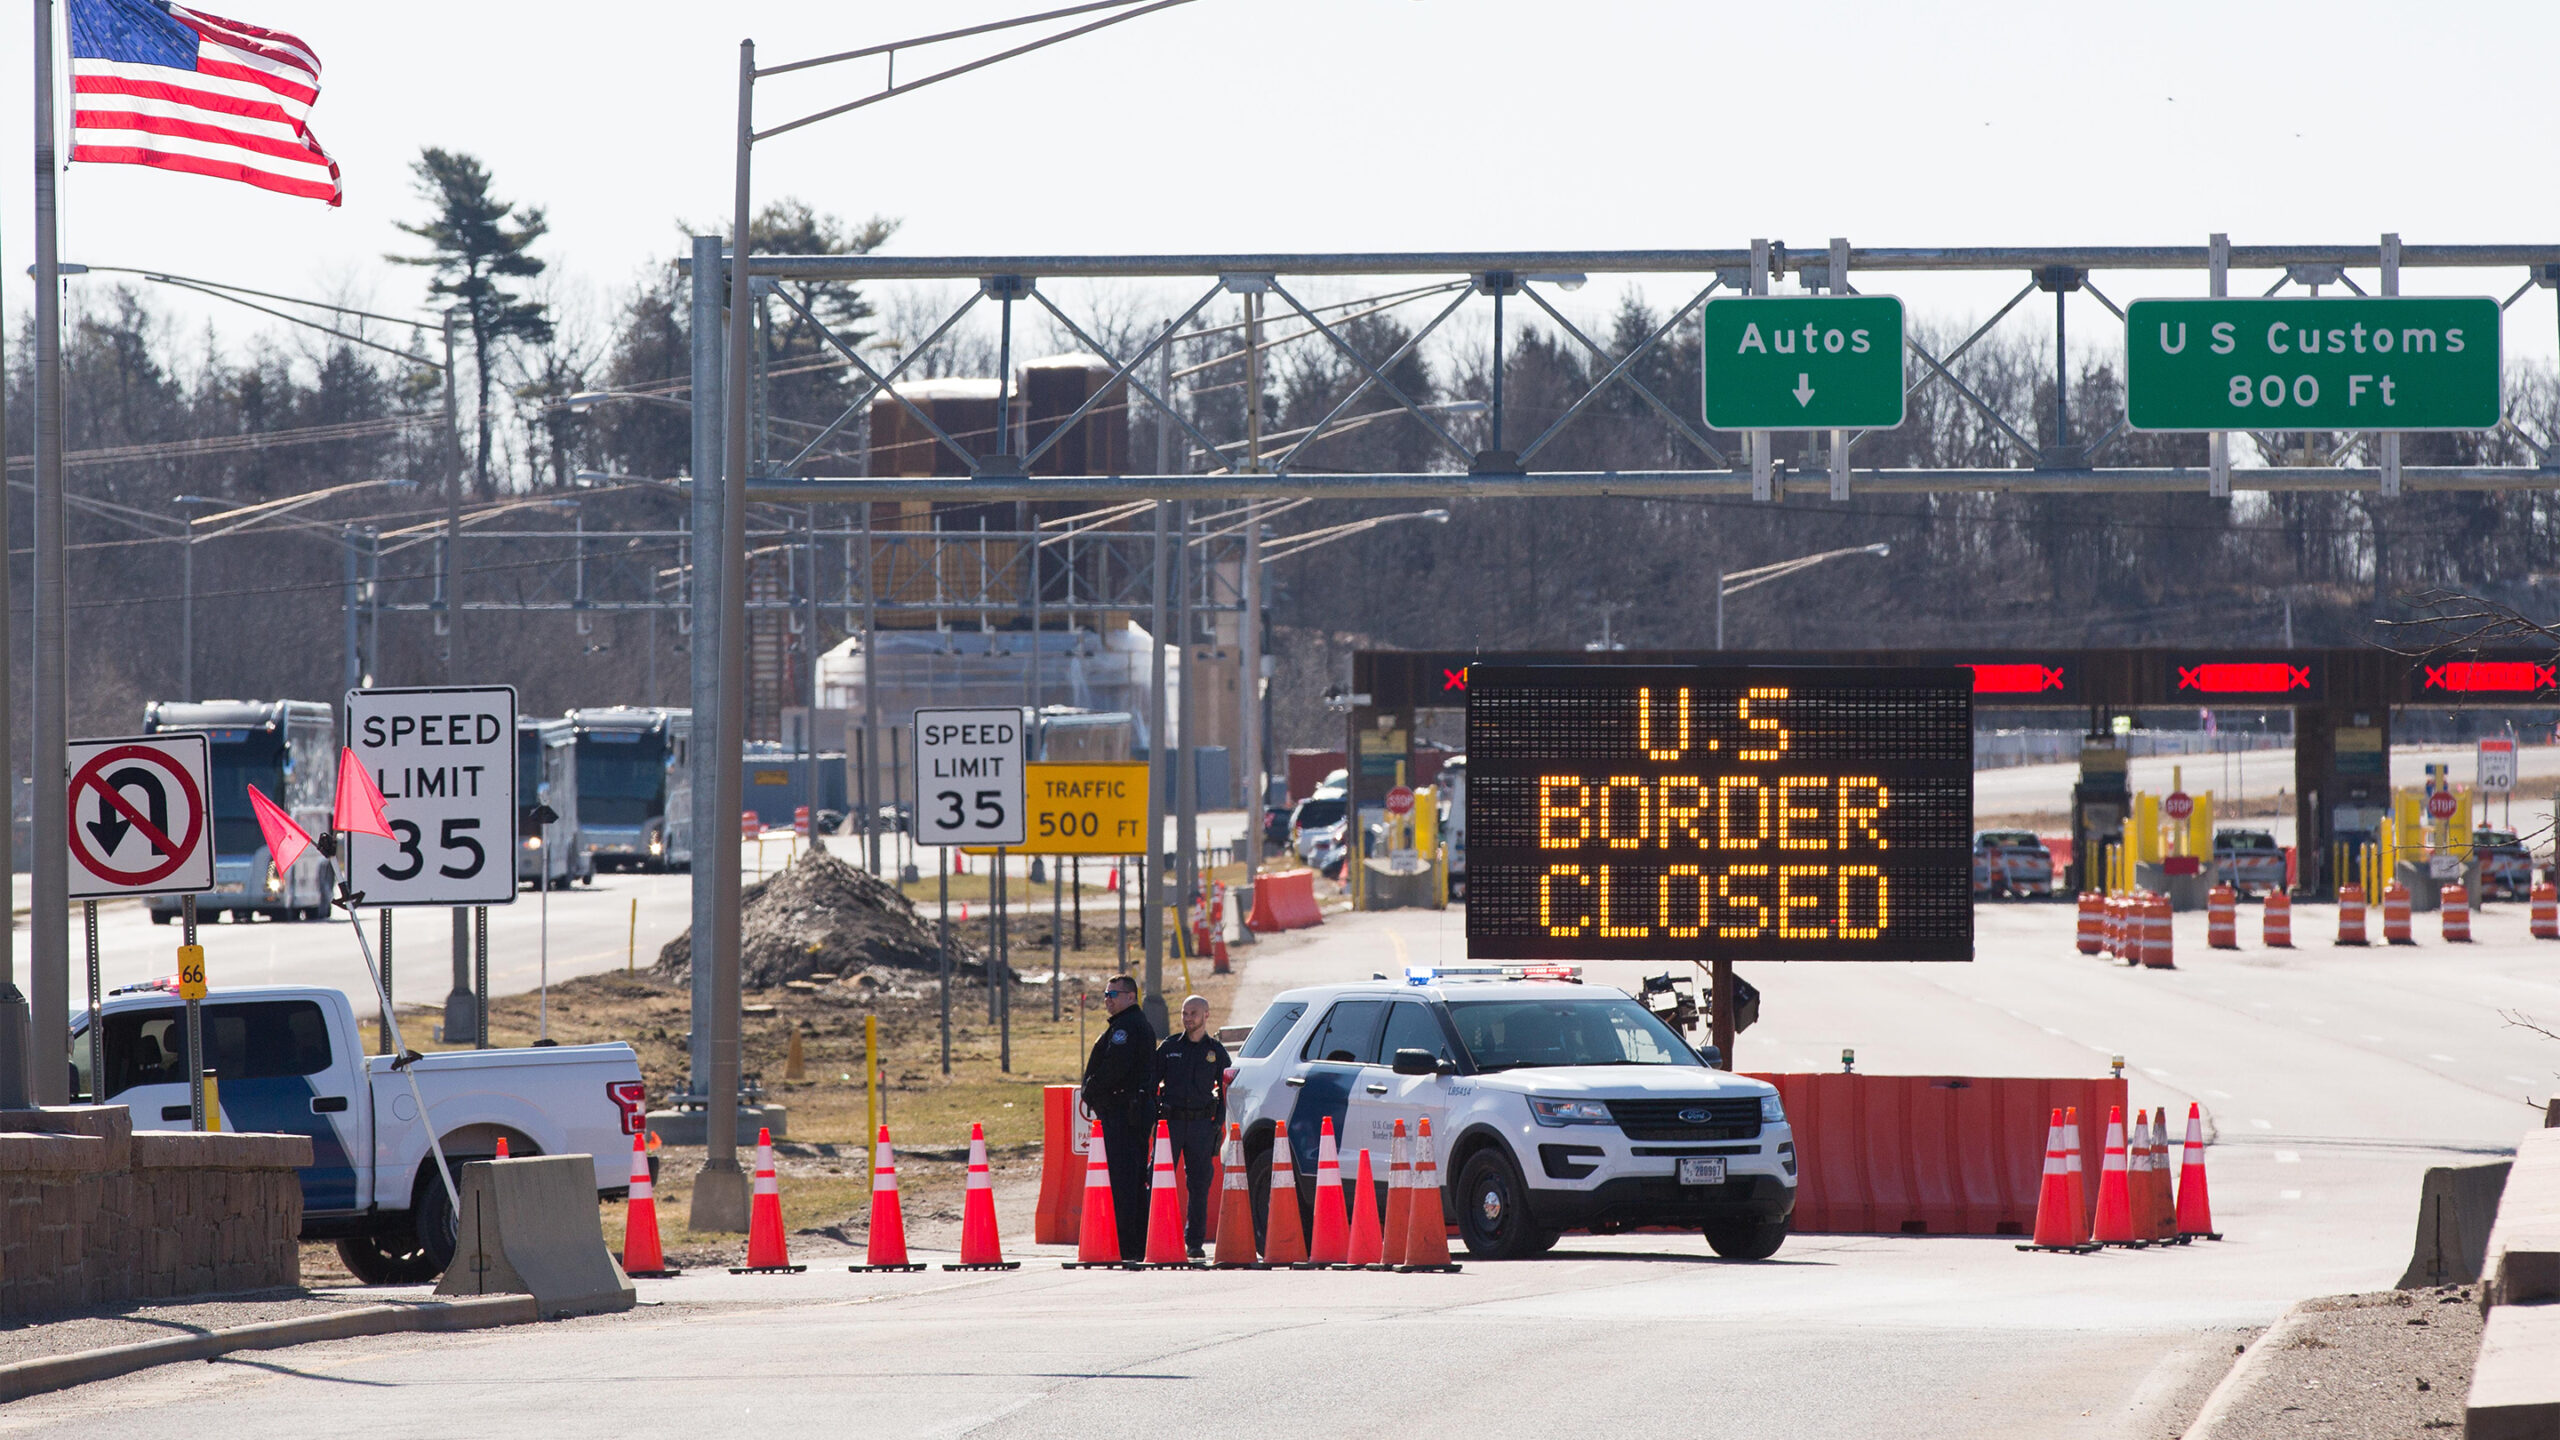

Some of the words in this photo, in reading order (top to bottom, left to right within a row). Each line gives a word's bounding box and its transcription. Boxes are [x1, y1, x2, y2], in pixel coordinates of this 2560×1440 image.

[1737, 322, 1871, 354] Autos
[2160, 322, 2187, 355] U
[2210, 321, 2237, 355] S
[2267, 321, 2466, 354] Customs
[2228, 374, 2320, 408] 800
[2349, 374, 2396, 407] Ft
[362, 713, 501, 748] SPEED
[924, 724, 1014, 746] SPEED
[1638, 686, 1791, 761] U.S
[378, 766, 485, 799] LIMIT
[934, 757, 1004, 778] LIMIT
[2484, 774, 2509, 787] 40
[1045, 780, 1126, 799] TRAFFIC
[1389, 795, 1414, 807] STOP
[936, 790, 1006, 830] 35
[1539, 775, 1889, 851] BORDER
[2430, 799, 2456, 813] STOP
[1039, 811, 1099, 837] 500
[1117, 819, 1139, 838] FT
[376, 817, 486, 881] 35
[1539, 863, 1889, 940] CLOSED
[182, 964, 203, 984] 66
